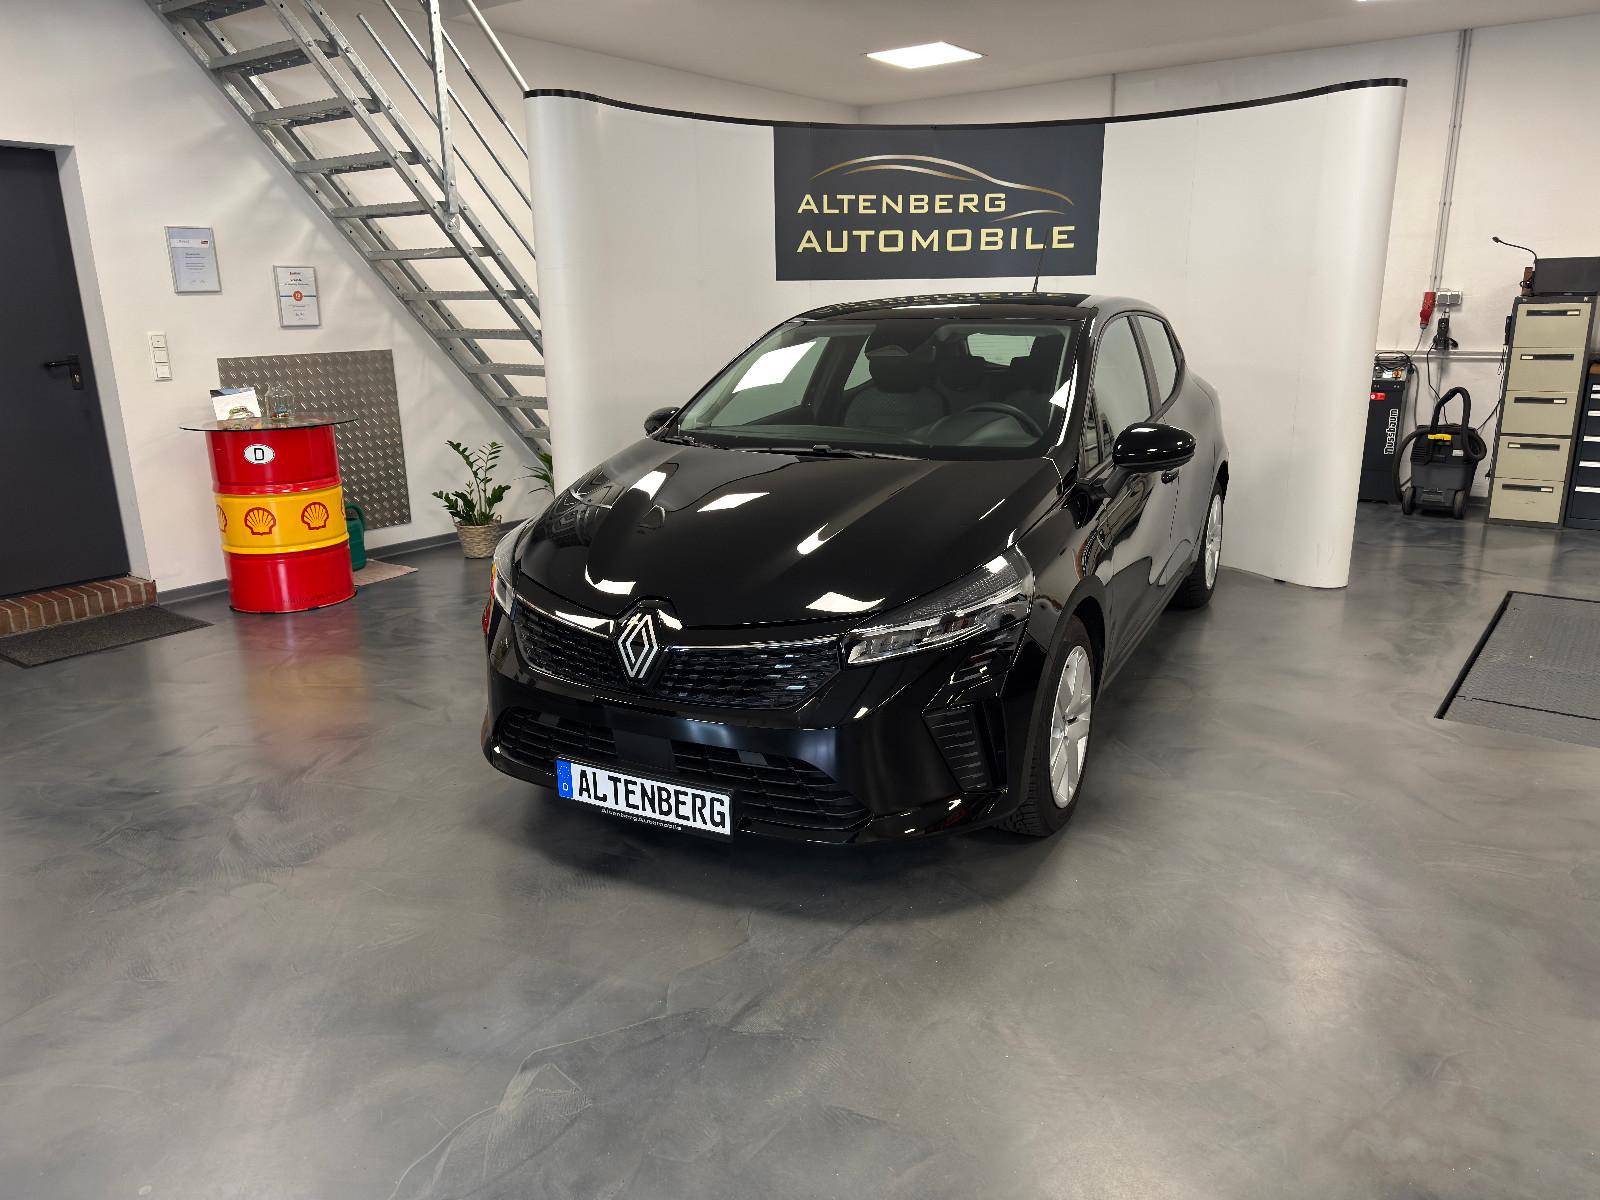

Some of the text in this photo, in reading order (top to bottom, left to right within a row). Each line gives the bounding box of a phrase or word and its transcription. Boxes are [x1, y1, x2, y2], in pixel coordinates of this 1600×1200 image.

[797, 193, 1006, 214] ALTENBERG
[797, 225, 1075, 253] AUTOMOBILE
[254, 448, 265, 461] D
[562, 782, 569, 792] D
[578, 769, 726, 829] ALTENBERG
